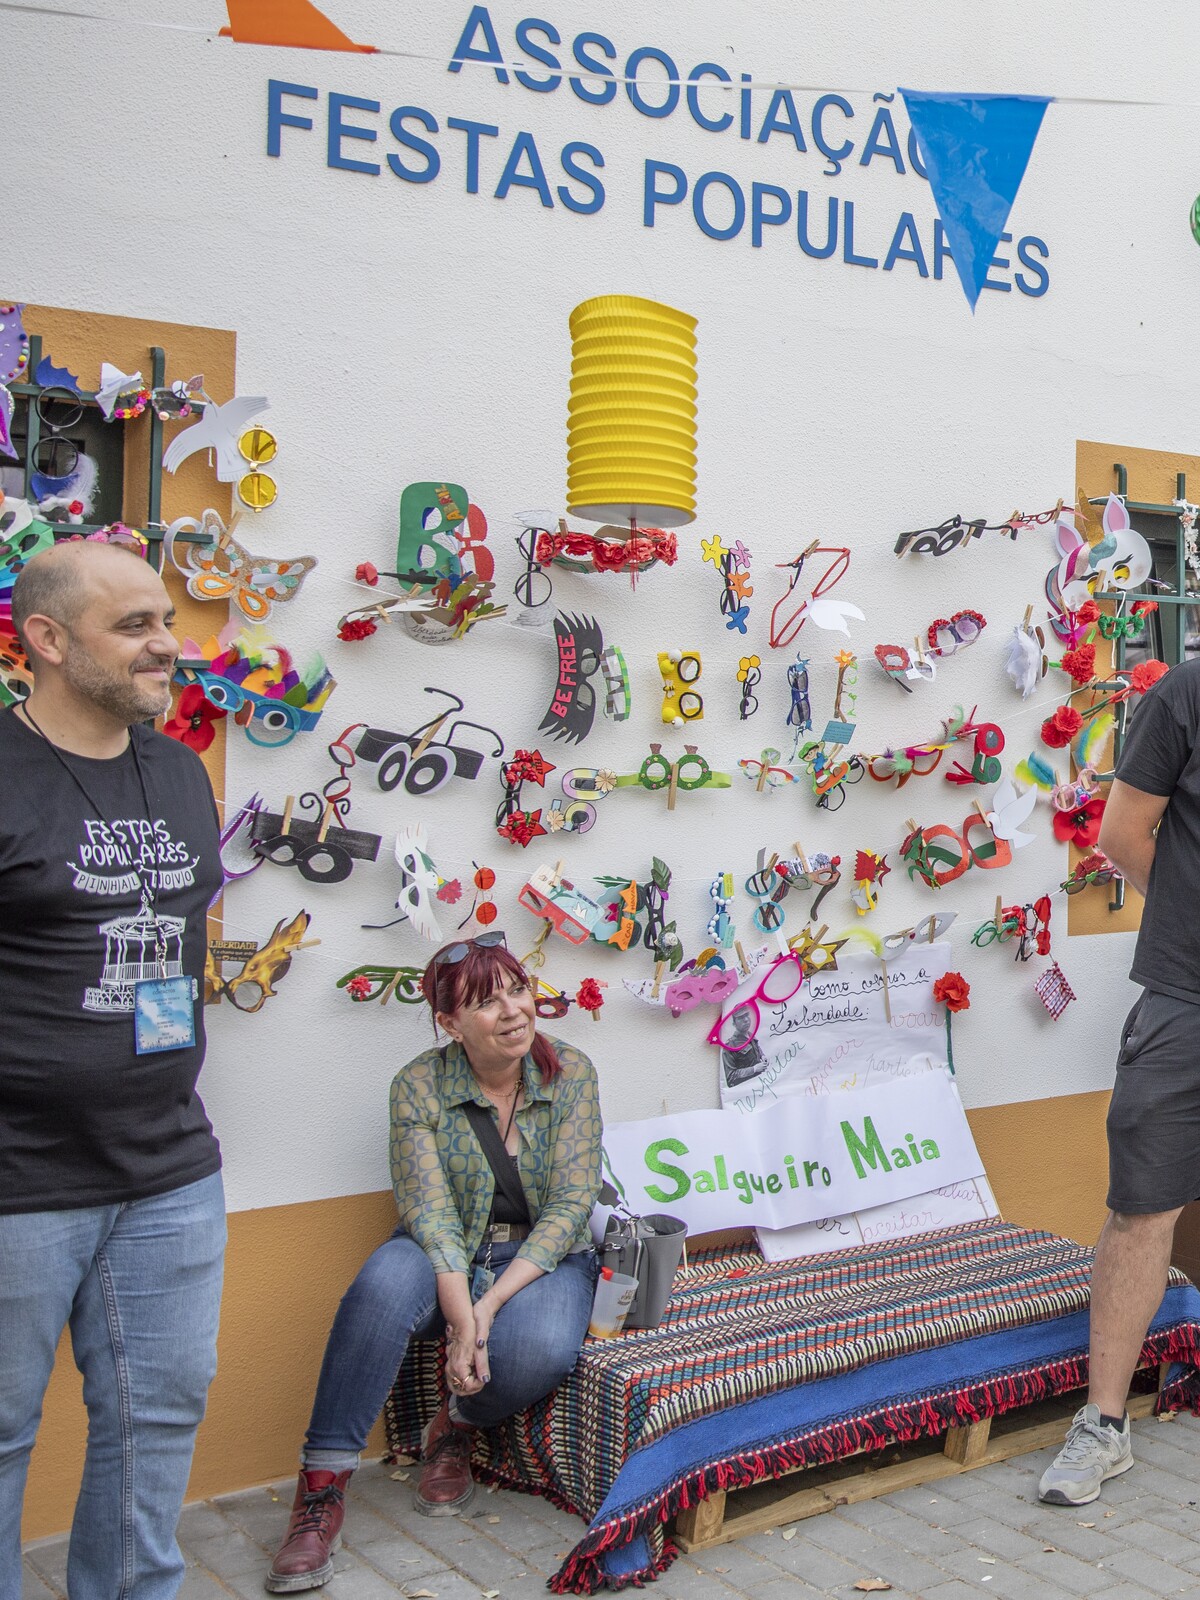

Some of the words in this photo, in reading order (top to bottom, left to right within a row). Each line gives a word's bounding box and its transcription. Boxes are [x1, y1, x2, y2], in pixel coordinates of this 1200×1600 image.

[265, 77, 607, 216] FESTAS
[557, 634, 577, 686] FREE
[550, 689, 573, 718] BE
[84, 819, 171, 845] FESTAS
[77, 874, 139, 890] PINHAL
[210, 940, 258, 950] LIBERDADE
[733, 1041, 807, 1115] respeitar
[643, 1136, 832, 1205] Salgueiro
[839, 1115, 941, 1180] Maia
[862, 1211, 944, 1240] aceitar
